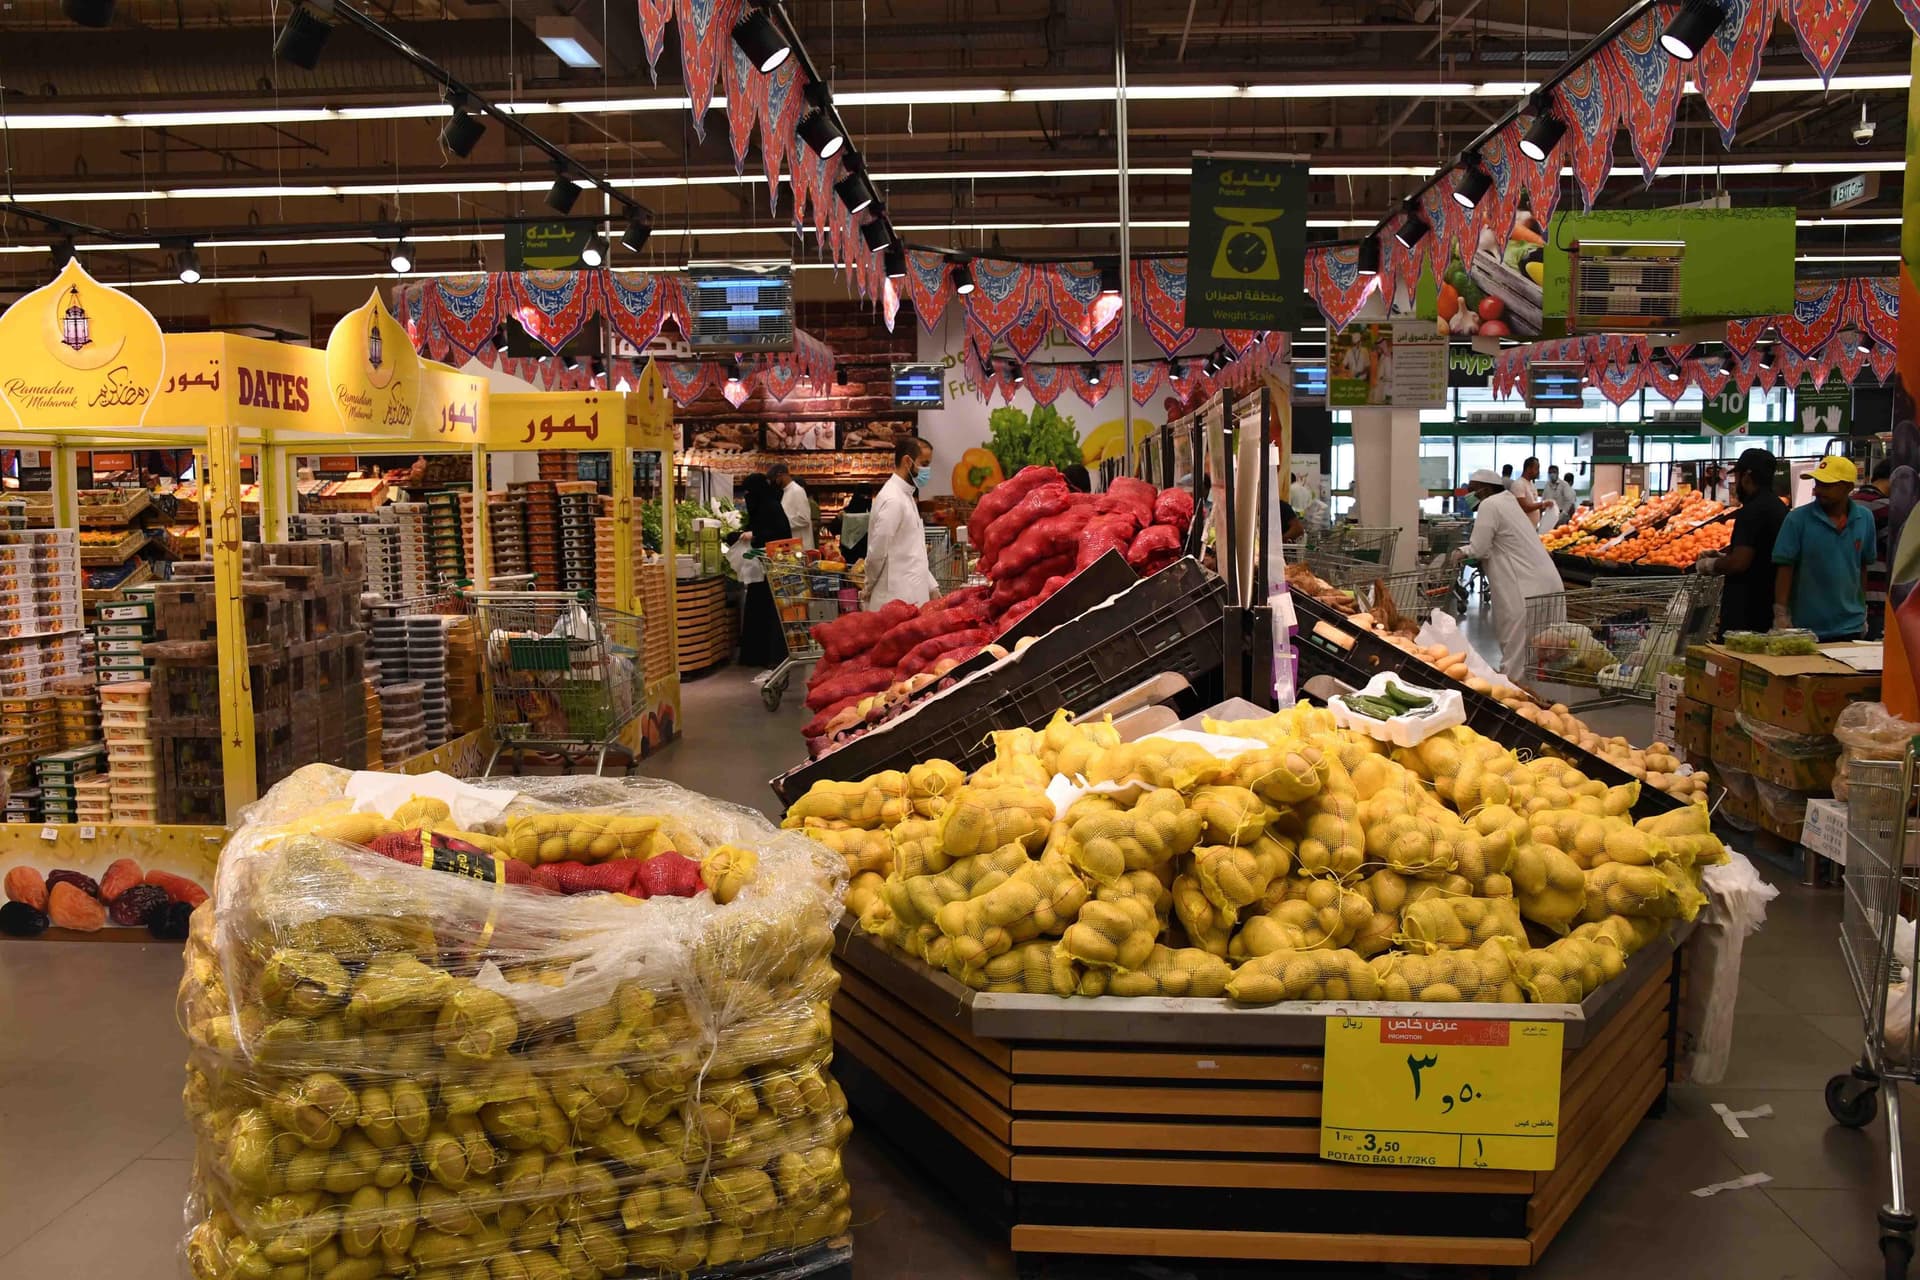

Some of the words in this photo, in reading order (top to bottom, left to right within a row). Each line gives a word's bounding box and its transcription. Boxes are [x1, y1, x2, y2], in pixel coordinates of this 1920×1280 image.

[1449, 347, 1494, 376] Hyp
[165, 360, 220, 393] تمور
[4, 378, 75, 397] Ramadan
[238, 366, 310, 413] DATES
[336, 383, 372, 407] Ramadan
[20, 395, 78, 409] Mubarak
[439, 384, 478, 434] تمور
[1708, 392, 1744, 414] -10
[344, 404, 373, 422] Mubarak
[519, 397, 599, 443] تمور
[1342, 1017, 1363, 1029] ريال
[1387, 1018, 1423, 1031] خاص
[1425, 1019, 1458, 1032] عرض
[1387, 1033, 1422, 1041] PROMOTION
[1335, 1131, 1340, 1141] 1
[1327, 1150, 1370, 1163] POTATO
[1372, 1154, 1395, 1164] BAG
[1398, 1155, 1436, 1165] 1.7/2KG
